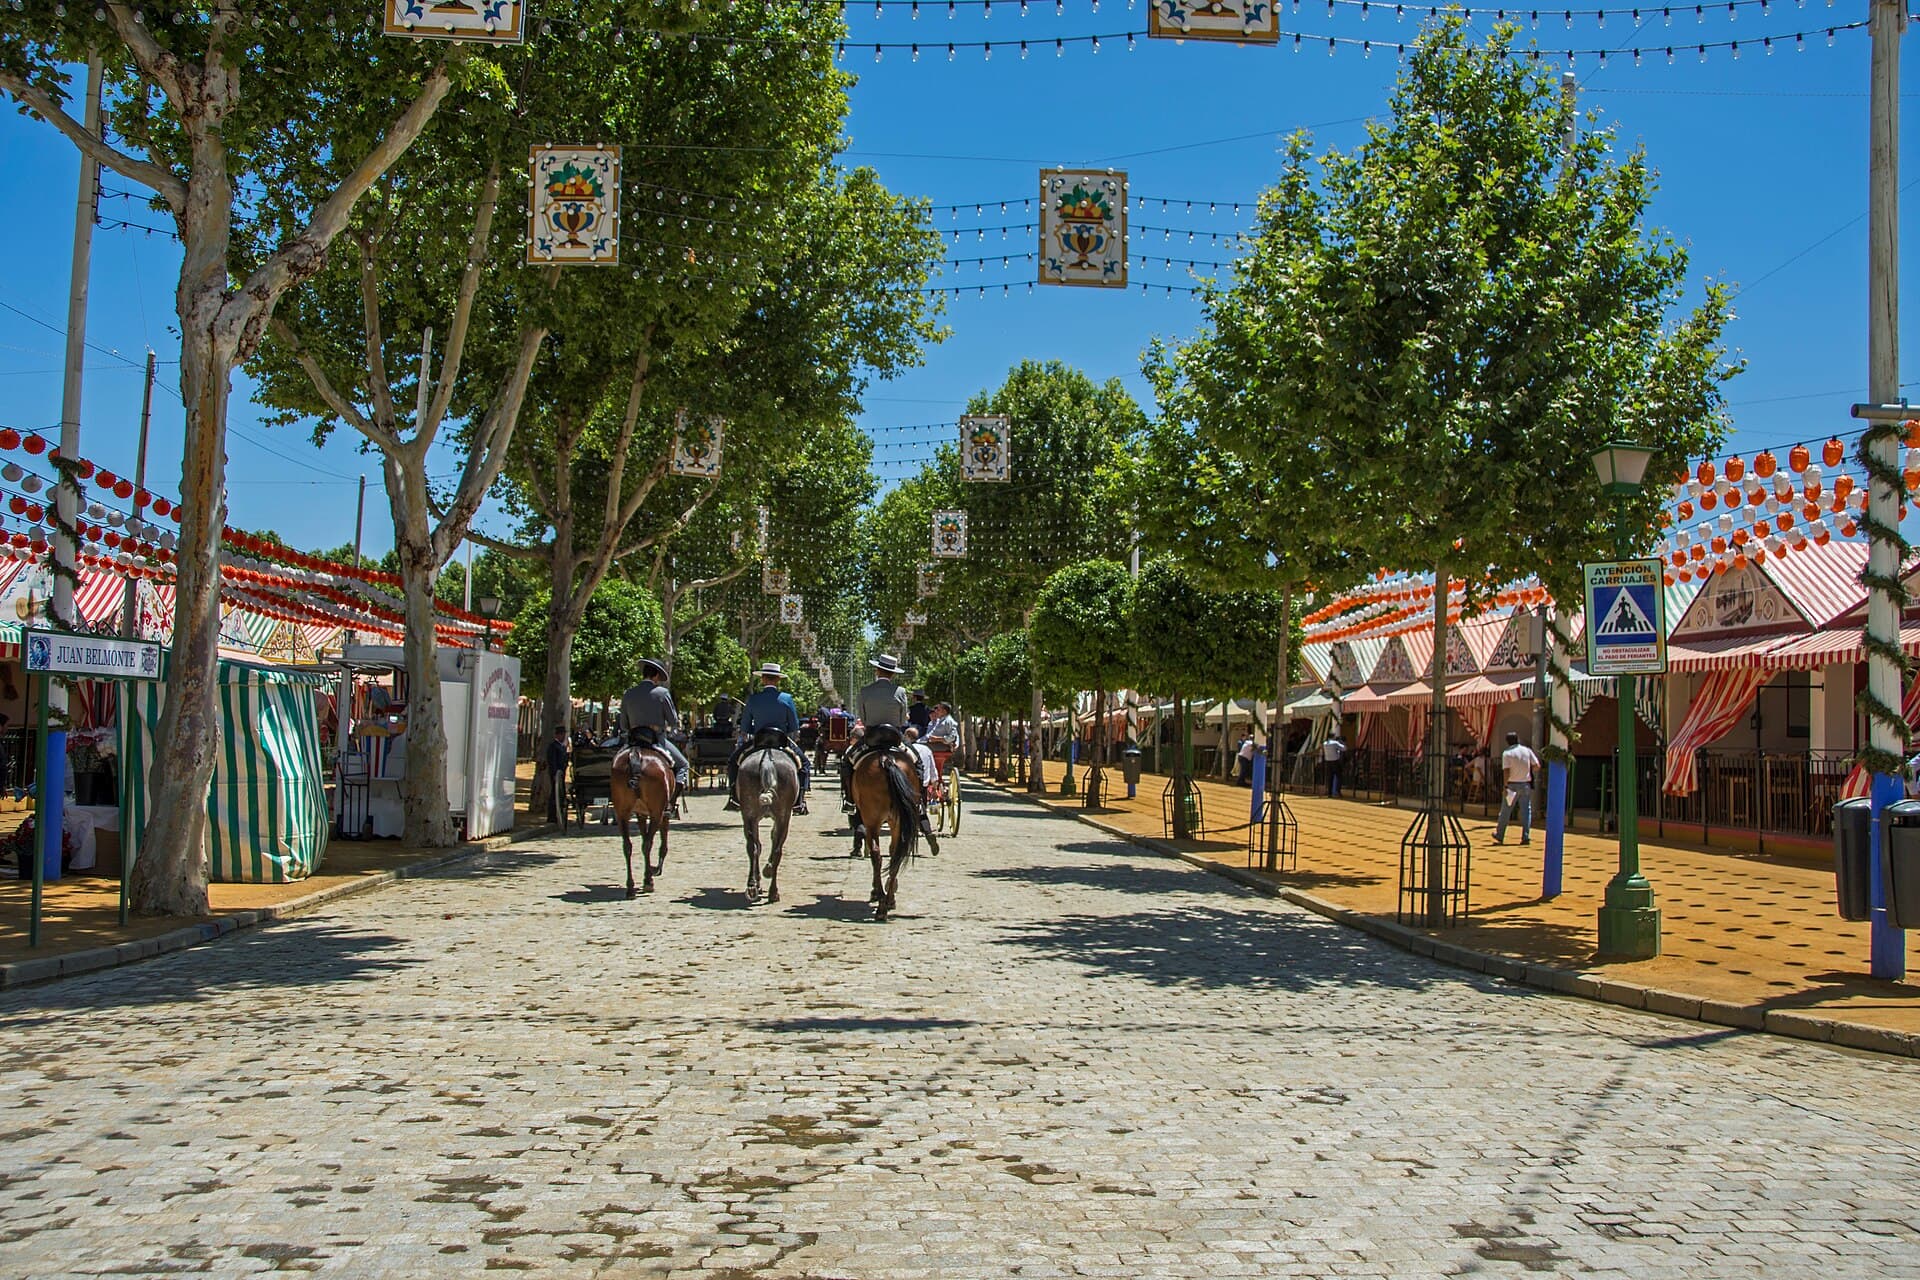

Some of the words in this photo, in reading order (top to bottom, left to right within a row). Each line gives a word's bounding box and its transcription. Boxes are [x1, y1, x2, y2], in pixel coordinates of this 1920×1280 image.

[1594, 564, 1652, 576] ATENCIÓN
[1590, 575, 1657, 585] CARRUAJES
[57, 646, 83, 664] JUAN
[85, 648, 136, 667] BELMONTE
